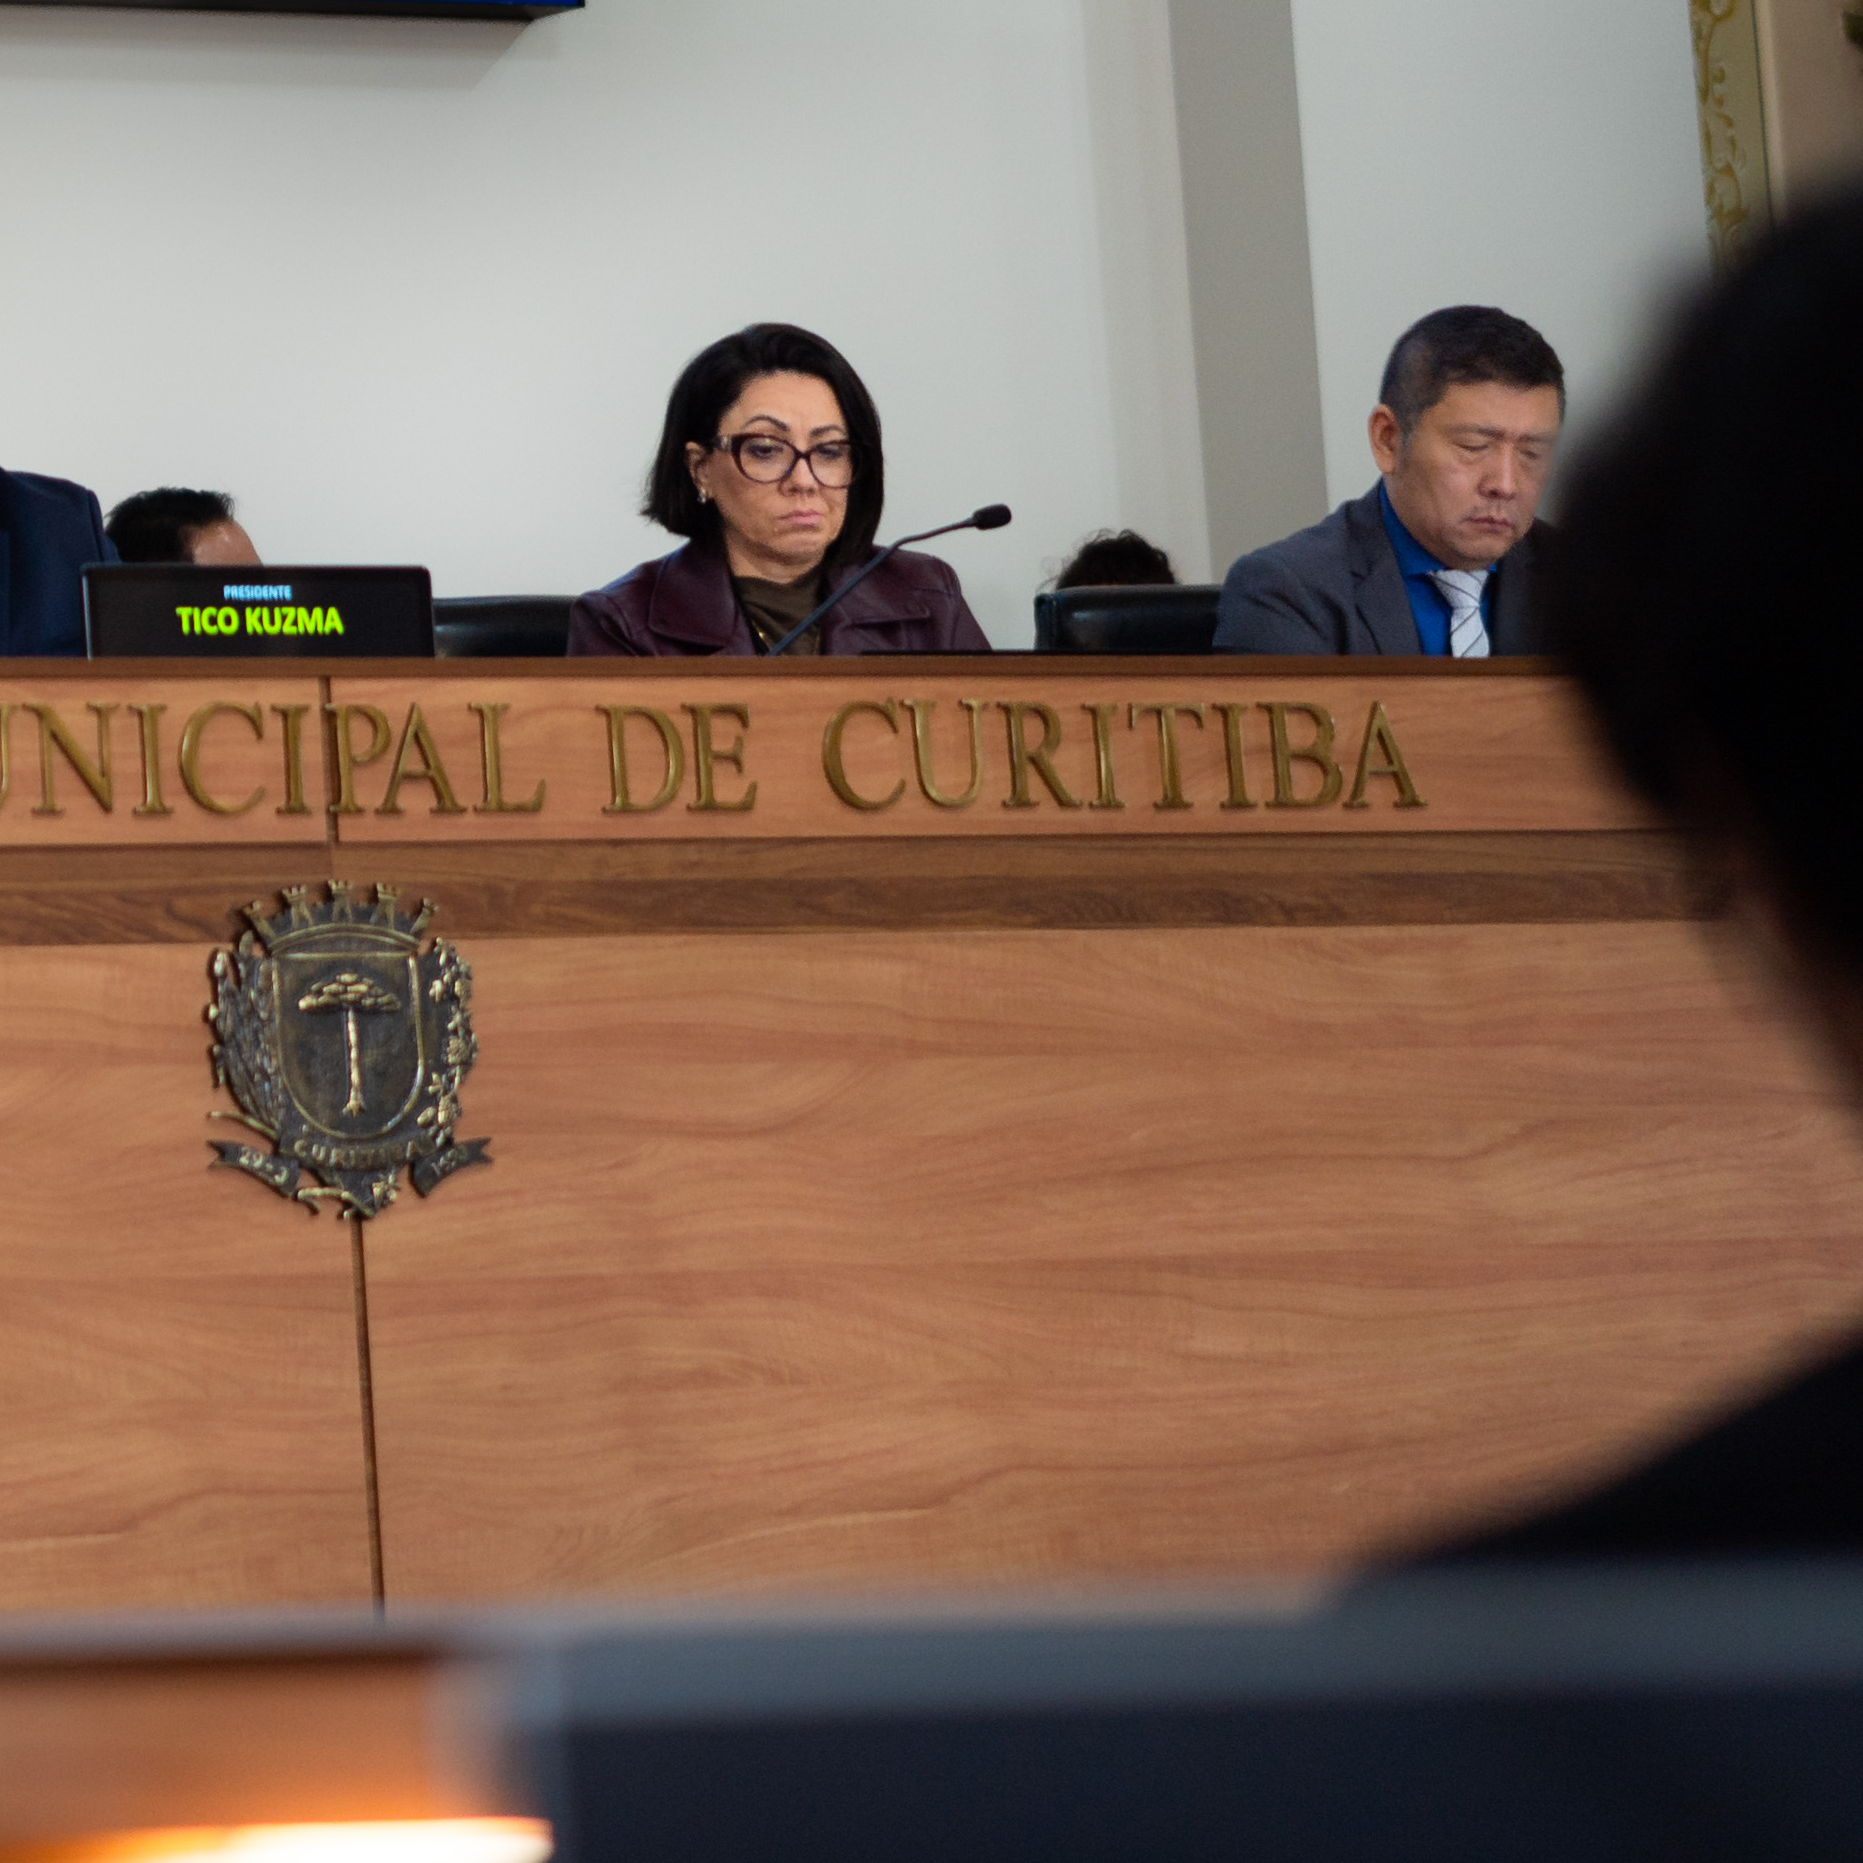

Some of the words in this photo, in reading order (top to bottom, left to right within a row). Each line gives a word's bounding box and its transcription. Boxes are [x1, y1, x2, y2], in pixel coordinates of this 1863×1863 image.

[224, 584, 291, 600] PRESIDENTE
[176, 606, 239, 635] TICO
[246, 606, 344, 635] KUZMA
[599, 701, 758, 815] DE
[822, 698, 1427, 812] CURITIBA
